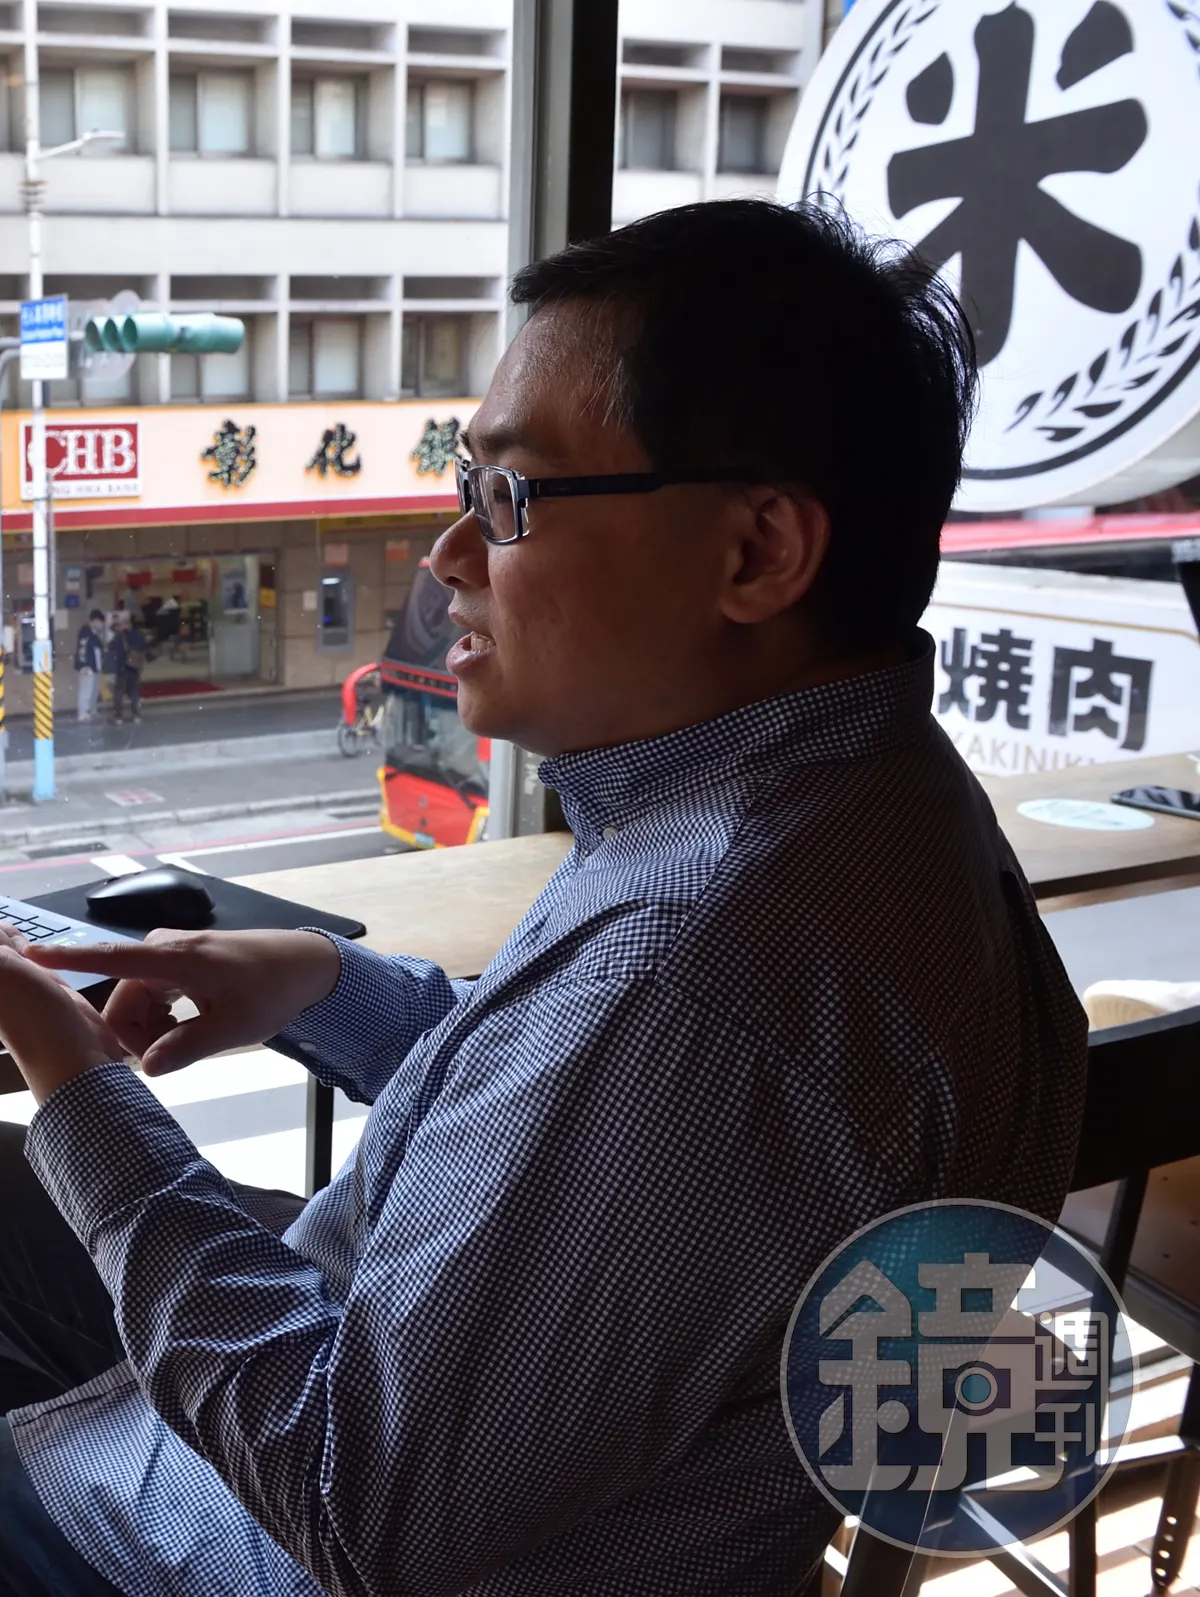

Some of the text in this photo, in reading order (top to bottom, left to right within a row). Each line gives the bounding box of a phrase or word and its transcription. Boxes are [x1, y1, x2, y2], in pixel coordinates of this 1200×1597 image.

[887, 0, 1148, 371] 米
[27, 427, 136, 476] CHB
[938, 627, 1155, 752] 燒肉
[952, 732, 1096, 773] AKINIK
